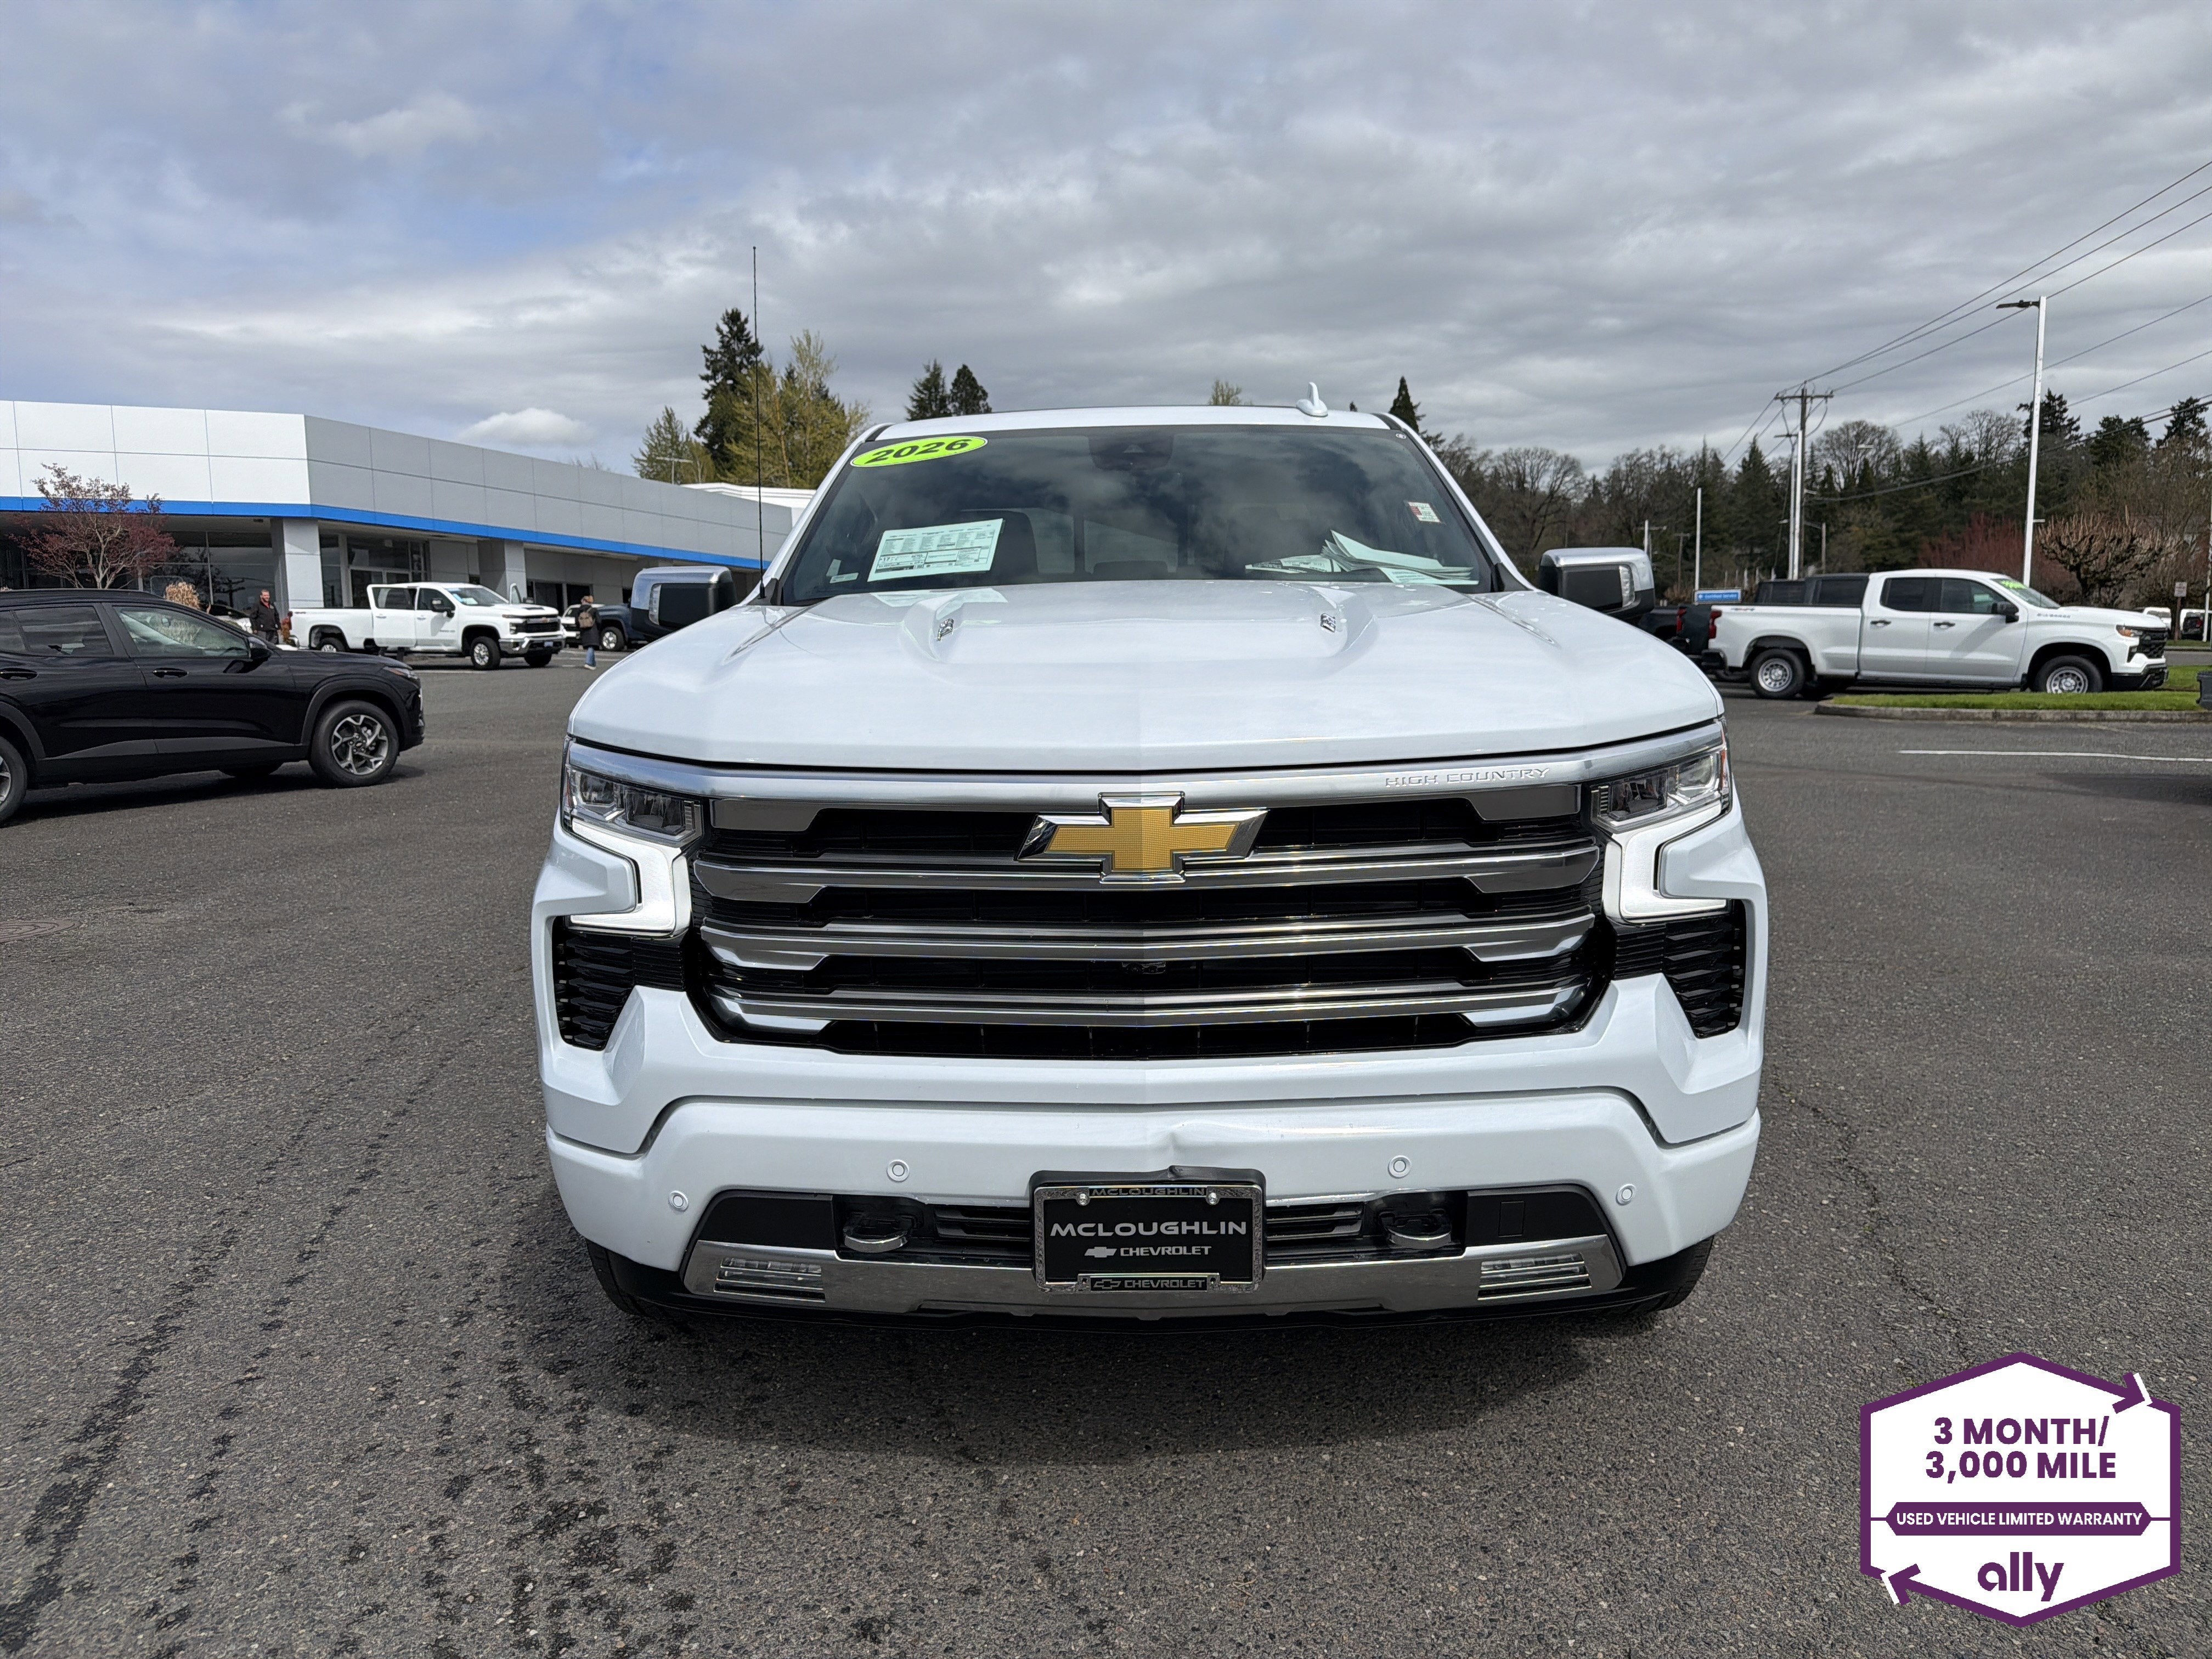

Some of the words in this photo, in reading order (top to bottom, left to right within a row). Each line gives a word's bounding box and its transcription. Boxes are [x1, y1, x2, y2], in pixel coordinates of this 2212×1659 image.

[864, 439, 972, 465] 2026
[1385, 775, 1439, 788] HIGH
[1447, 768, 1550, 783] COUNTRY
[1092, 1188, 1205, 1196] MCLOUGHLIN
[1051, 1222, 1246, 1236] MCLOUGHLIN
[1120, 1246, 1211, 1256] CHEVROLET
